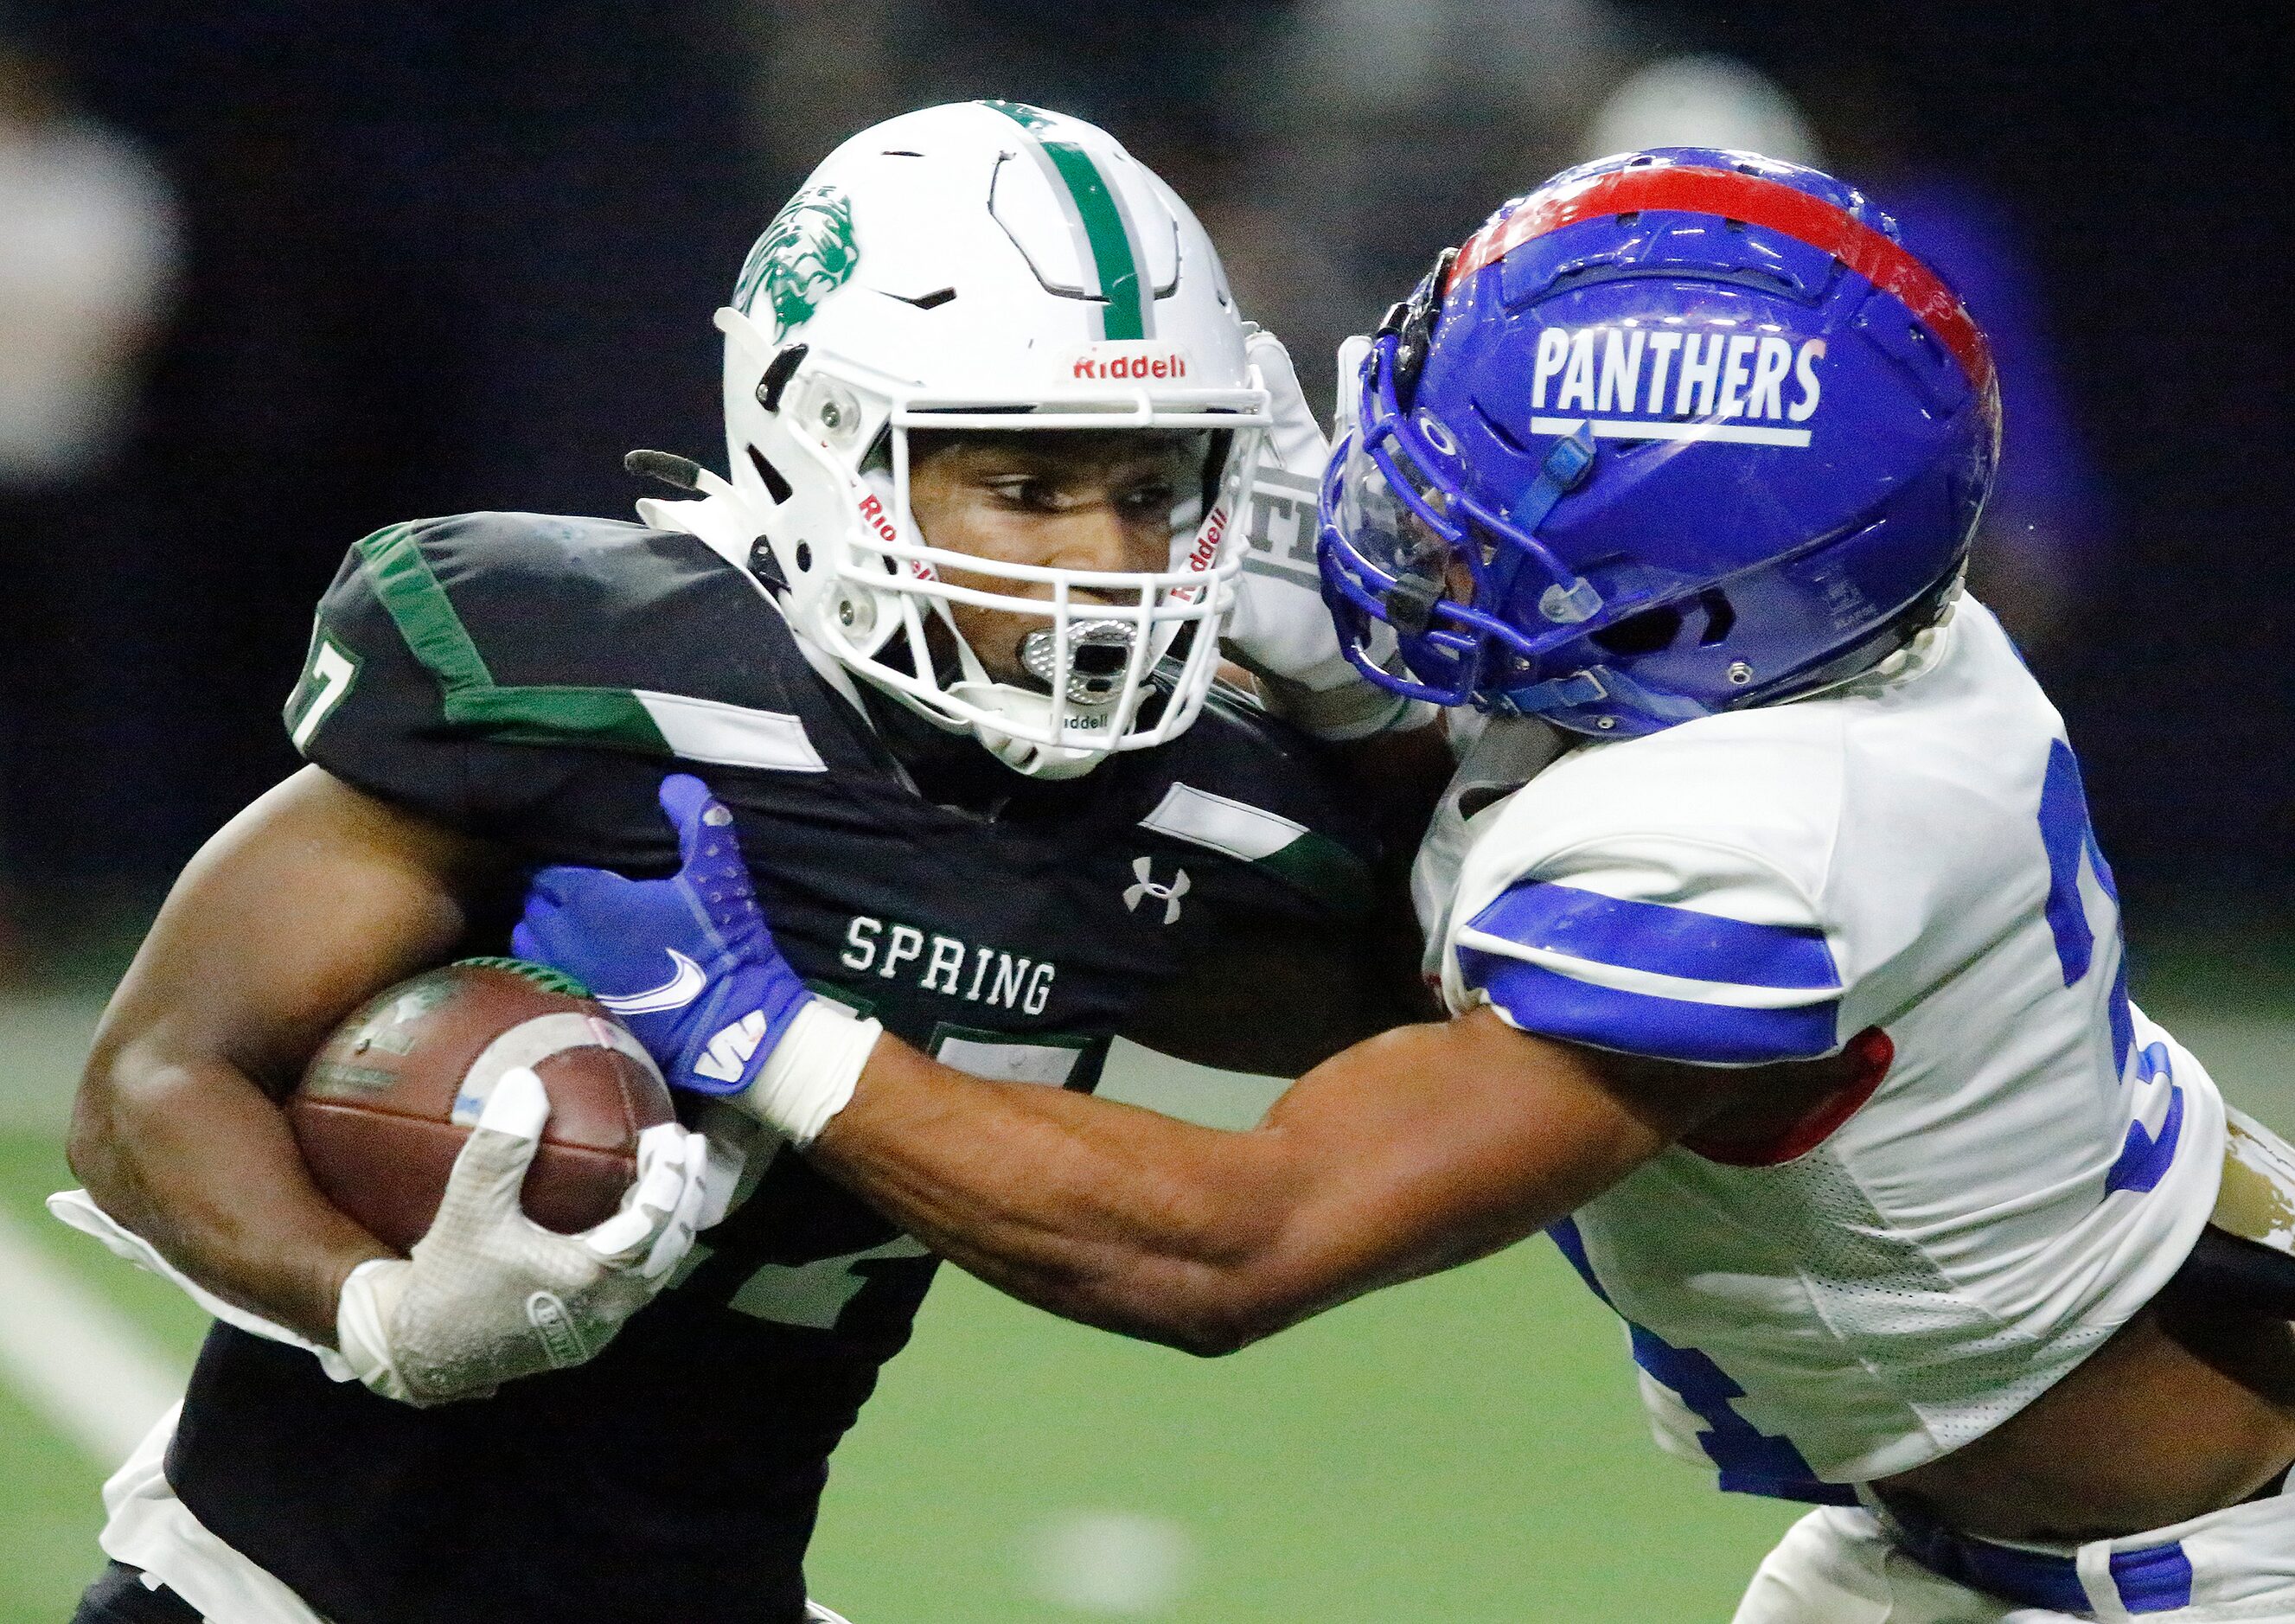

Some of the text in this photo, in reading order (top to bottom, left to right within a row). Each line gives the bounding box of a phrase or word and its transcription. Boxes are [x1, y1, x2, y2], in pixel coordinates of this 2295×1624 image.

[1073, 355, 1186, 378] Riddell
[1531, 327, 1826, 422] PANTHERS
[1049, 713, 1108, 729] iddell
[841, 916, 1055, 1015] SPRING
